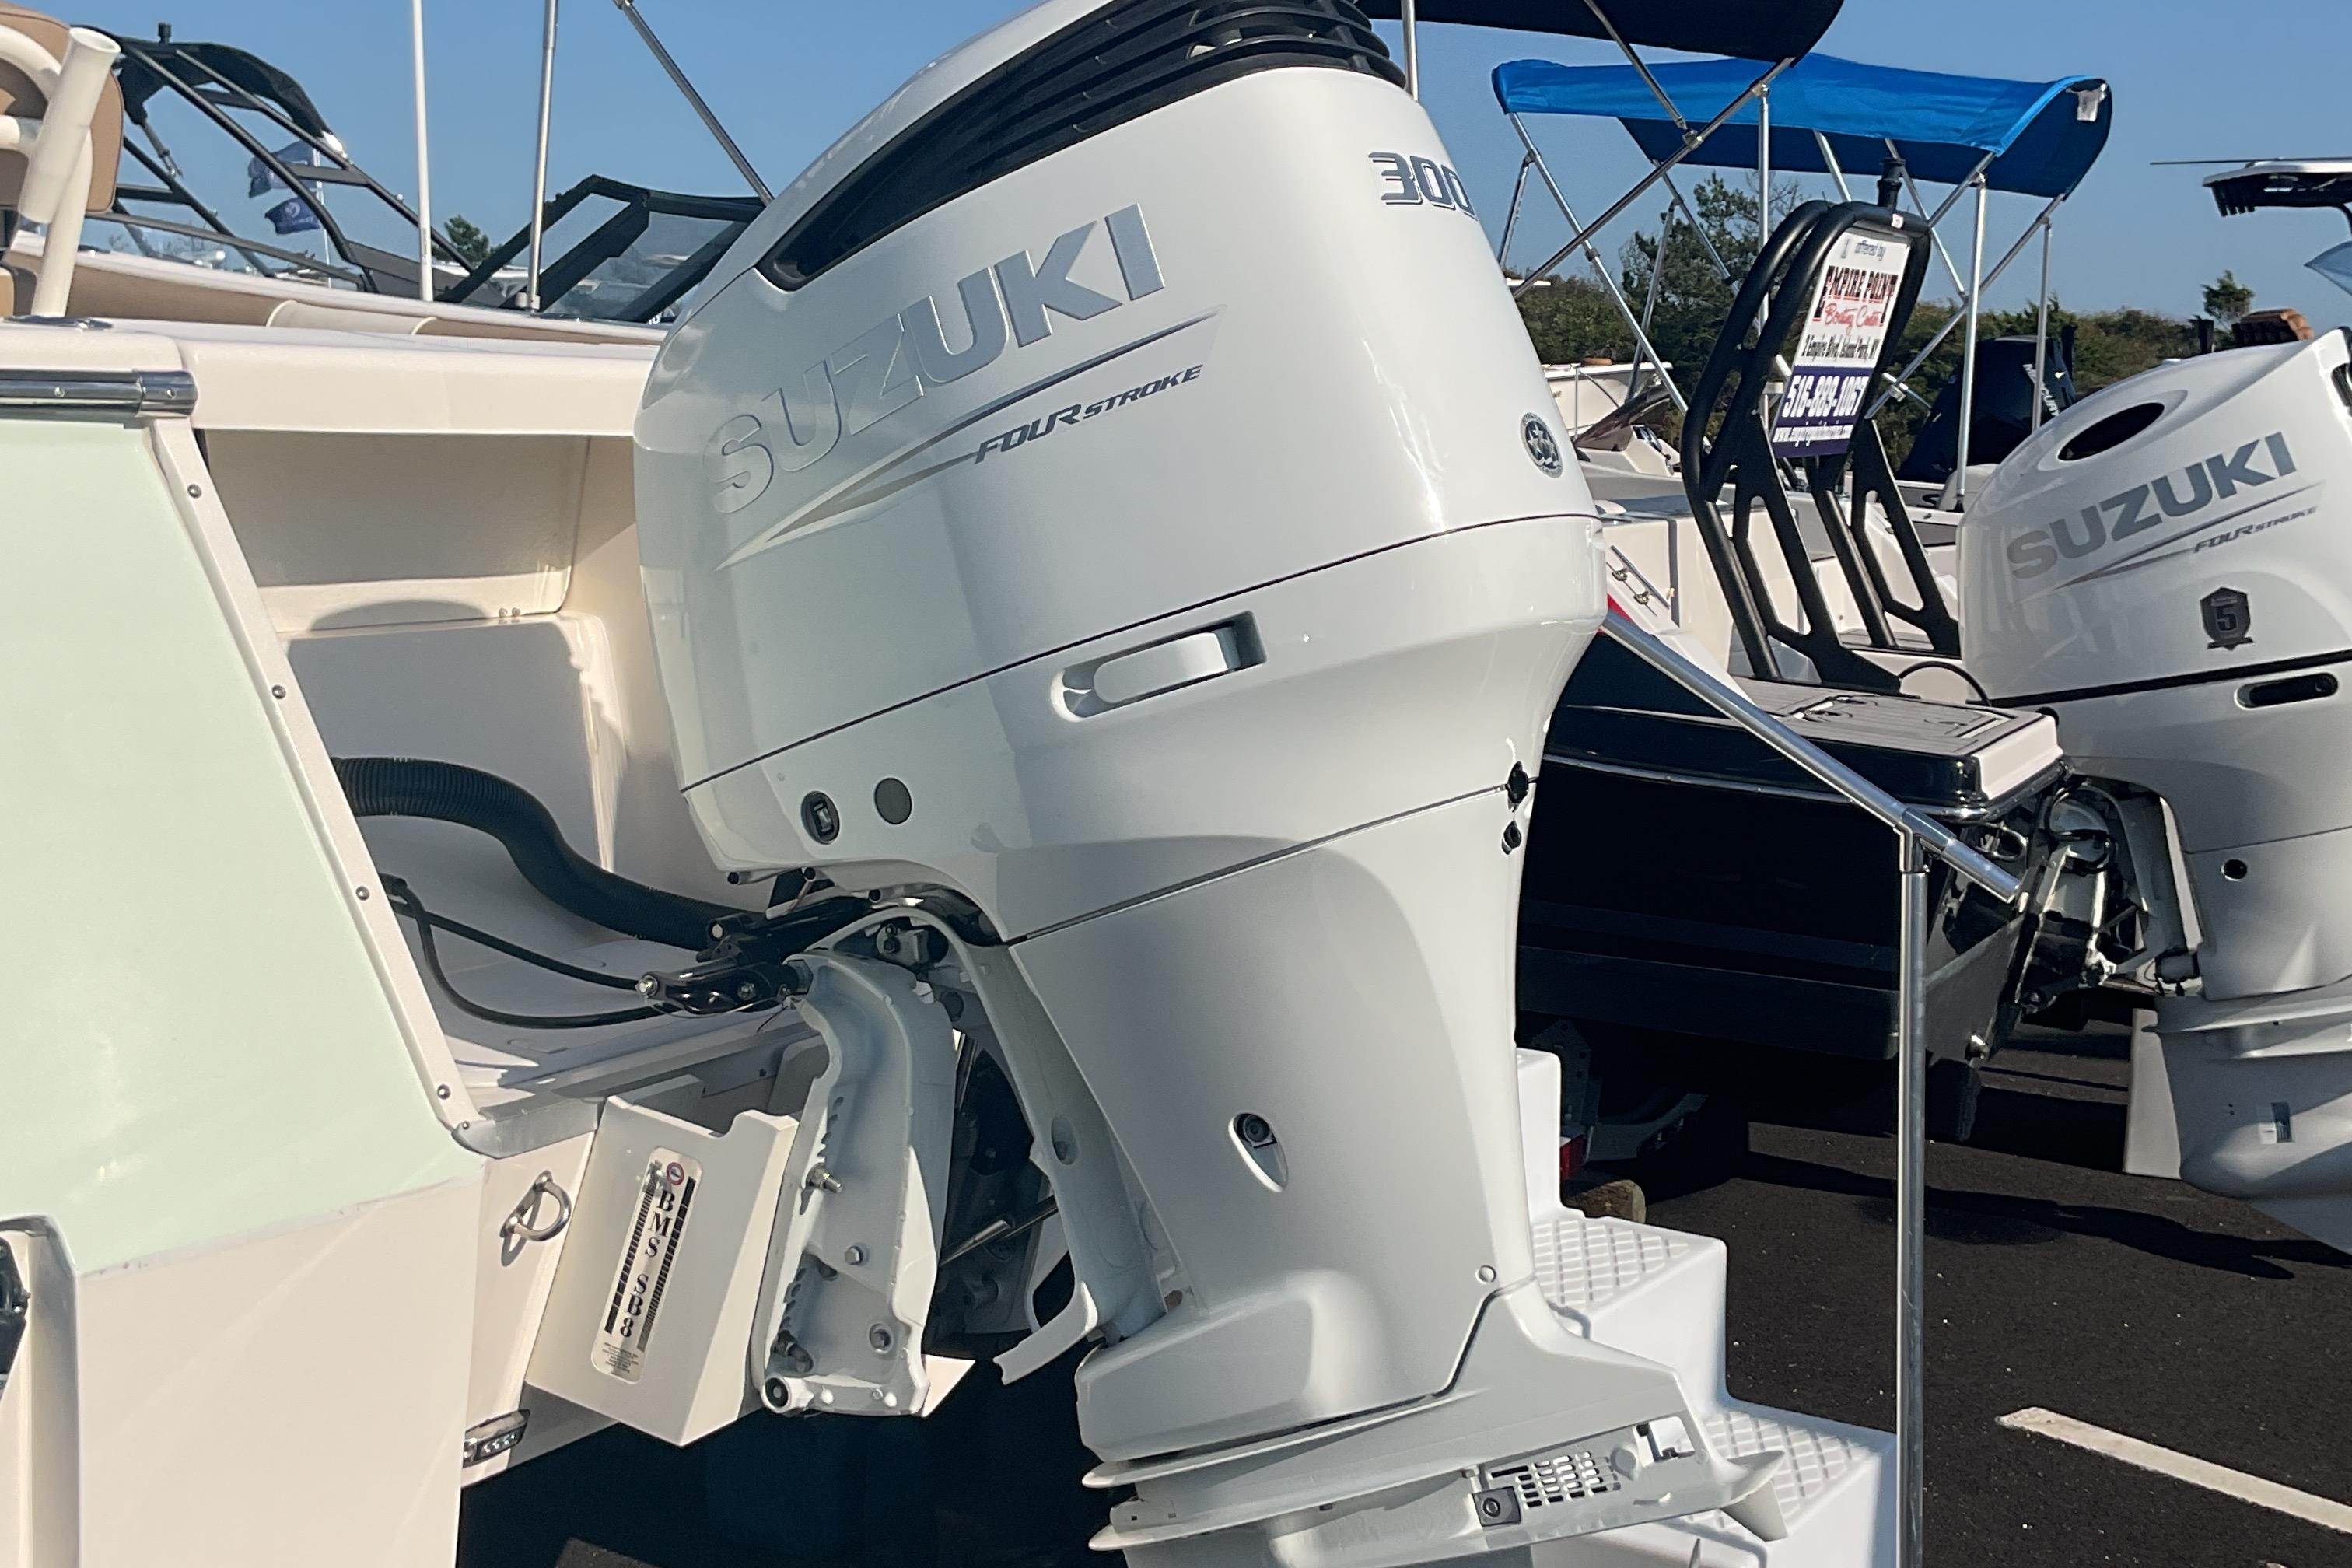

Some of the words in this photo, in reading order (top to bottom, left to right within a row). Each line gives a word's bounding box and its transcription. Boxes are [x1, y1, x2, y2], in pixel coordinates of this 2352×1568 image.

[1368, 152, 1478, 220] 300
[1812, 264, 1867, 318] EMPIRE
[1863, 271, 1899, 324] POINT
[1822, 302, 1859, 334] Boating
[703, 203, 1164, 513] SUZUKI
[2006, 431, 2296, 580] SUZUKI
